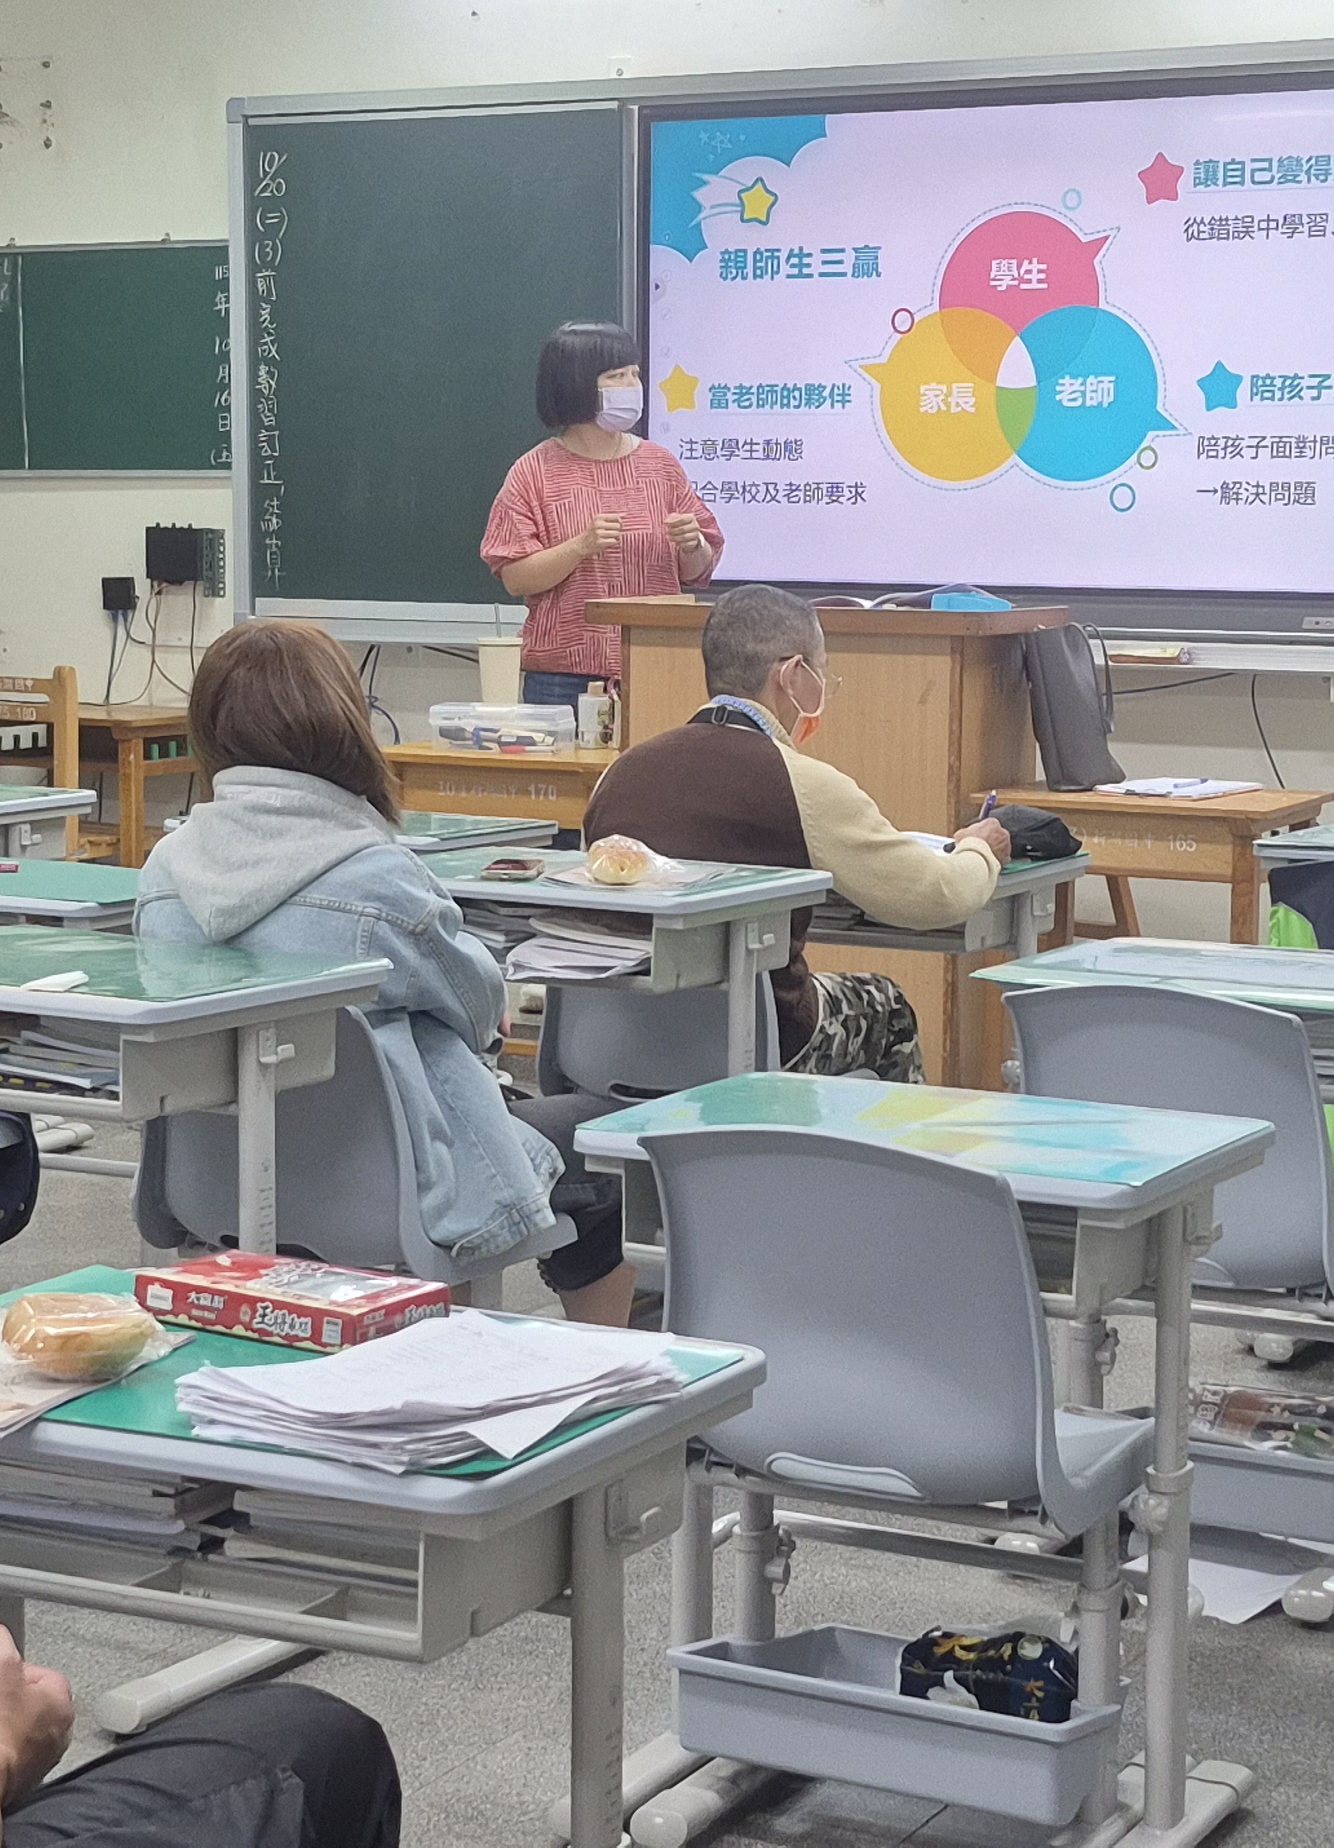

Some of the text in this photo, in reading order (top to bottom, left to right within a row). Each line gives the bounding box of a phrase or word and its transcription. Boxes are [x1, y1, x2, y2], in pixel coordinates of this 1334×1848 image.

[989, 257, 1049, 291] 學生
[707, 382, 853, 411] 當老師的夥伴
[919, 382, 976, 414] 家長
[1054, 374, 1116, 409] 老師
[678, 436, 805, 462] 注意學生動態
[527, 782, 558, 802] 170
[1167, 832, 1198, 853] 165
